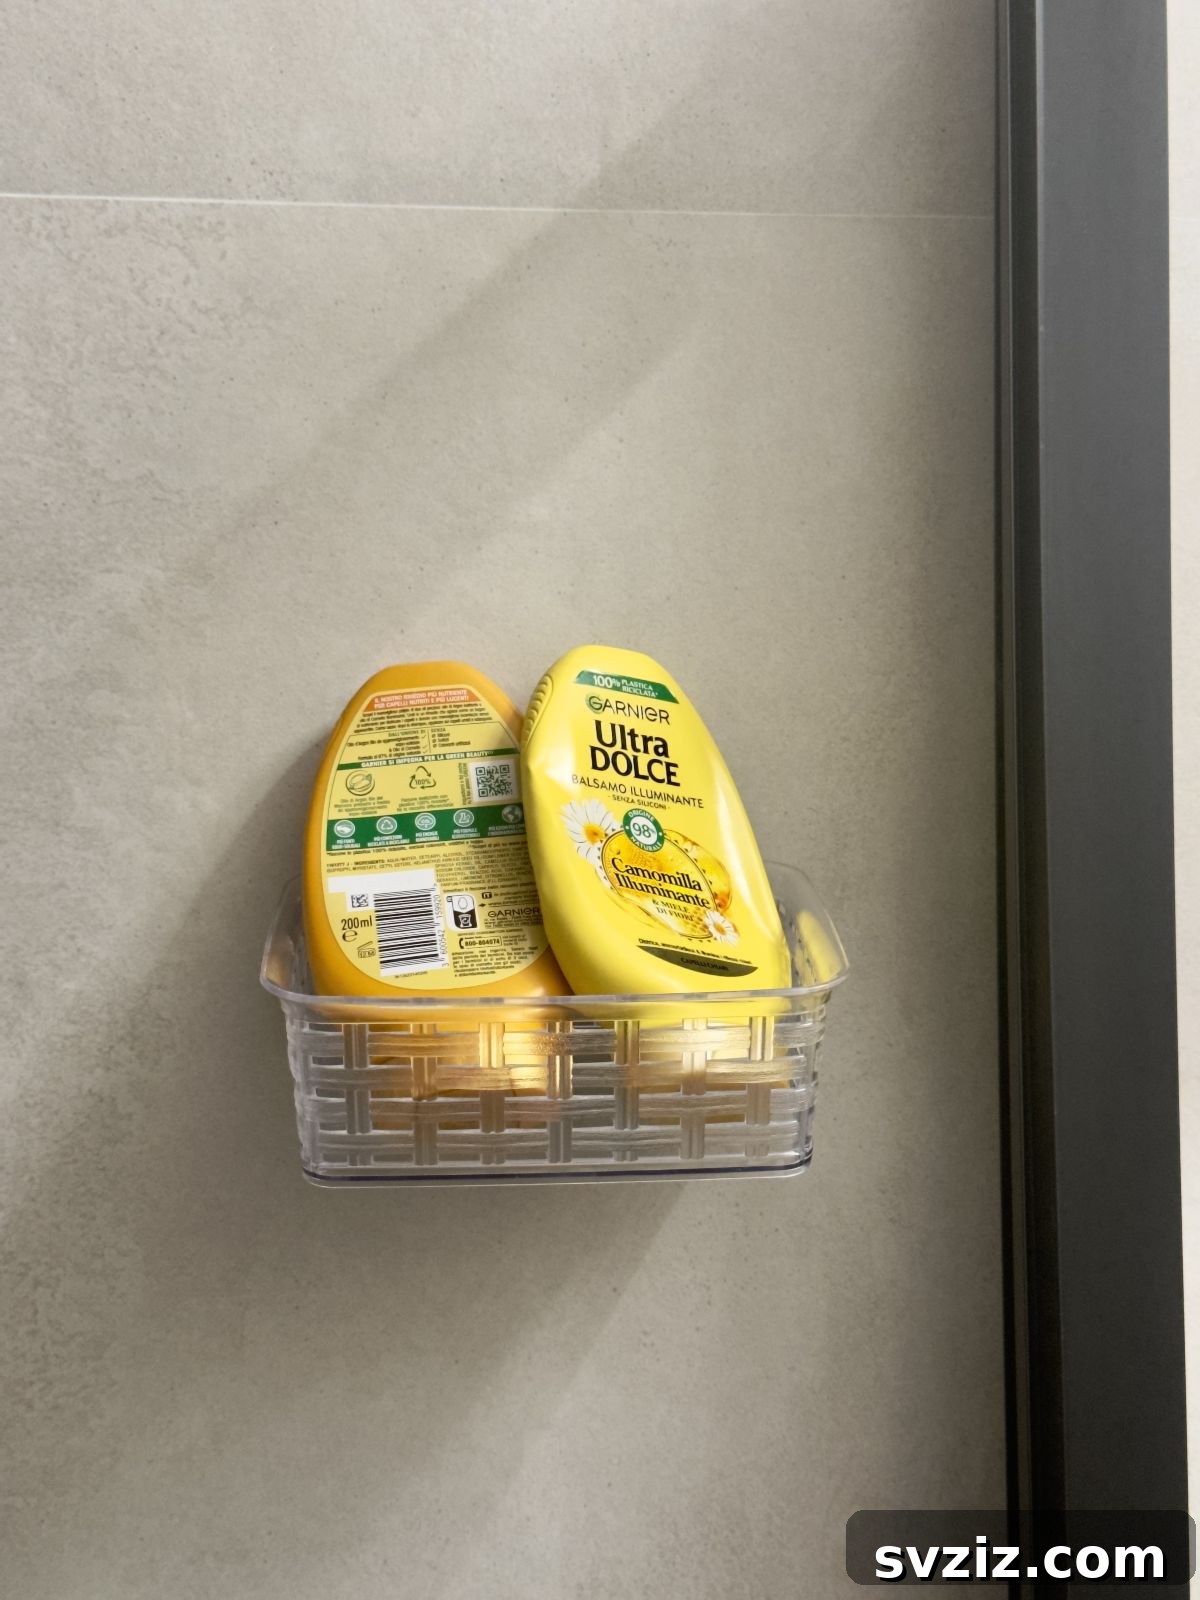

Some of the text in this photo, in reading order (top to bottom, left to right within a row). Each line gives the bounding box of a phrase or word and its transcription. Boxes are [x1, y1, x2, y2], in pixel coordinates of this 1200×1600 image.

[593, 674, 621, 689] 100%
[621, 679, 653, 691] PLASTICA
[587, 695, 670, 725] GARNIER
[594, 719, 670, 758] Ultra
[589, 745, 681, 787] DOLCE
[571, 774, 705, 809] BALSAMO ILLUMINANTE
[612, 794, 667, 810] SENZA SILICONI
[611, 857, 703, 892] Camomilla
[614, 872, 712, 910] Illuminante
[341, 915, 373, 931] 200ml
